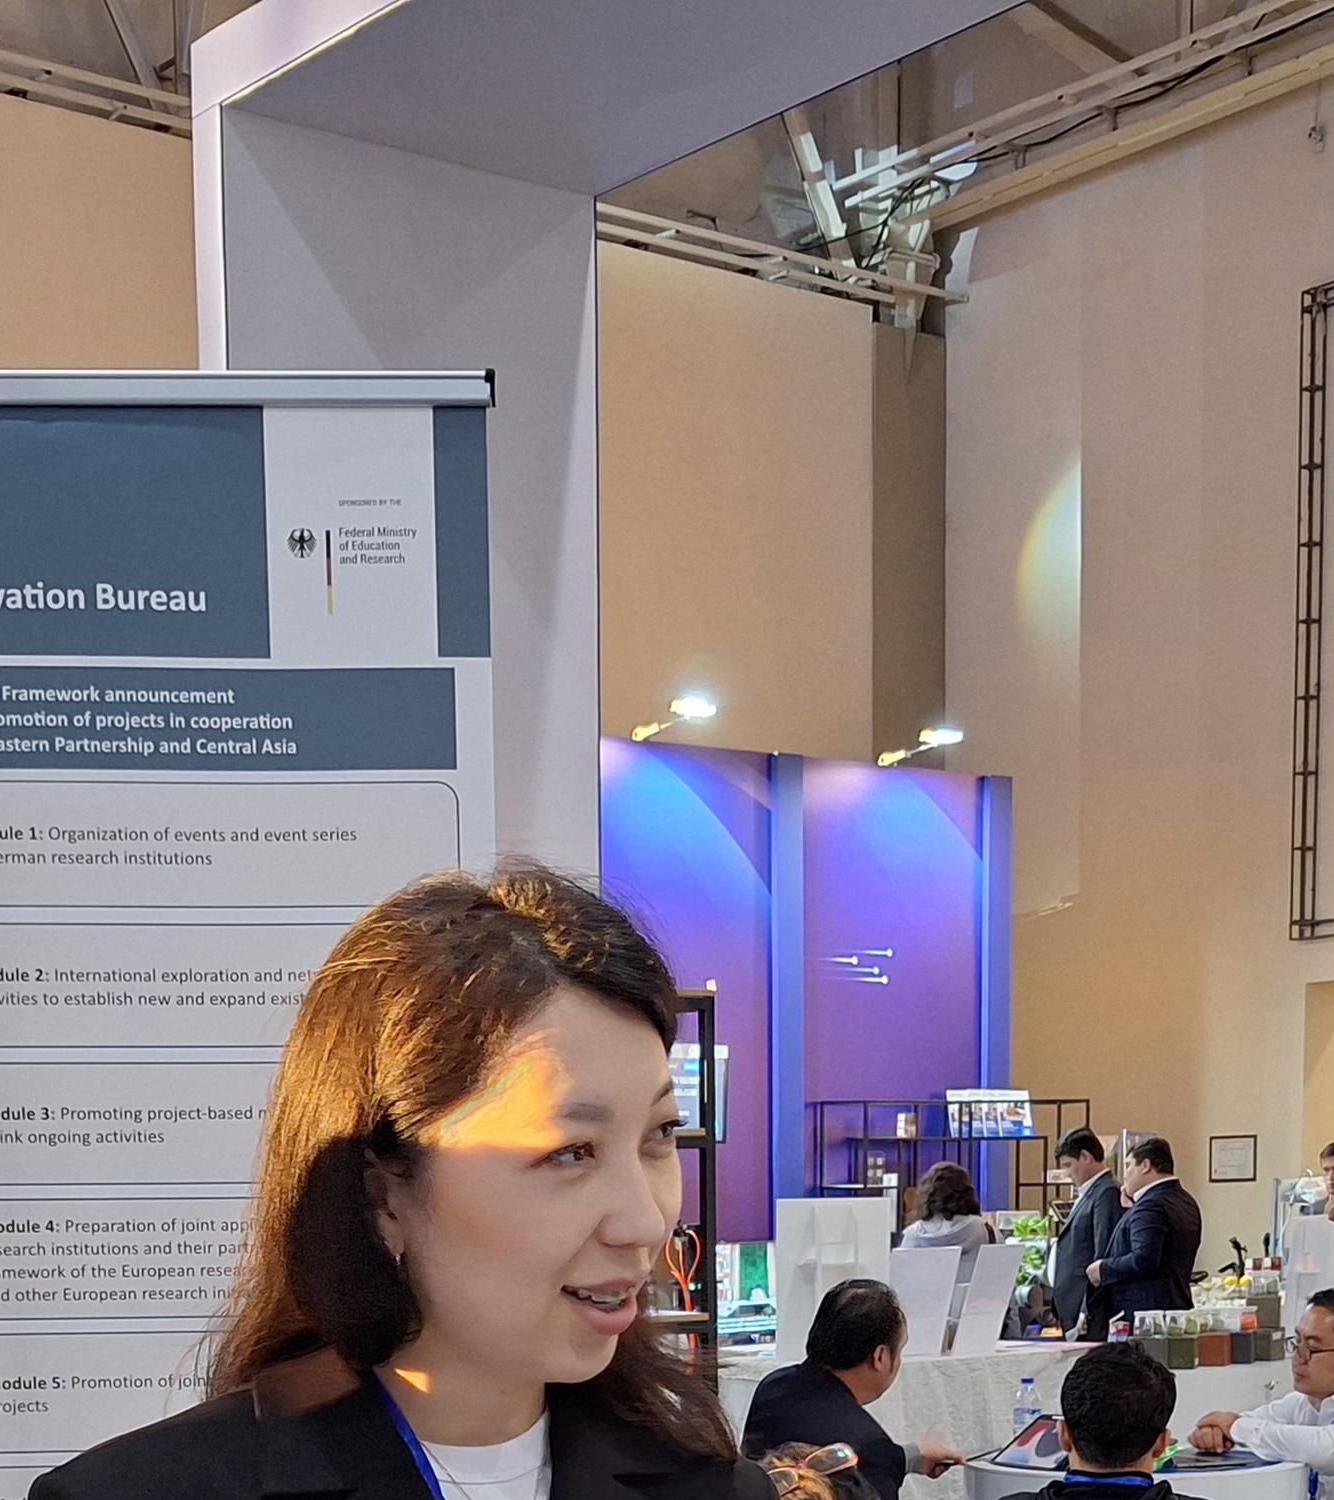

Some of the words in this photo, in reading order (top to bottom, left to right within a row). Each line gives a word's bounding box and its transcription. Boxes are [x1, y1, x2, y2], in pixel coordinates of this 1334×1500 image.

[338, 526, 375, 538] Federal
[377, 526, 417, 539] Ministry
[338, 539, 350, 552] of
[351, 539, 401, 552] Education
[339, 553, 358, 565] and
[360, 552, 406, 565] Research
[96, 582, 206, 612] Bureau
[1, 685, 101, 702] Framework
[104, 689, 235, 704] announcement
[72, 710, 92, 727] of
[95, 711, 165, 731] projects
[169, 712, 186, 729] in
[190, 712, 293, 733] cooperation
[54, 736, 155, 757] Partnership
[159, 737, 191, 754] and
[195, 737, 257, 755] Central
[261, 738, 297, 755] Asia
[29, 826, 44, 841] 1:
[48, 826, 149, 845] Organization
[153, 826, 170, 842] of
[174, 829, 226, 842] events
[230, 826, 259, 842] and
[264, 828, 308, 842] event
[312, 827, 357, 842] series
[51, 849, 119, 865] research
[124, 850, 213, 866] institutions
[34, 968, 50, 983] 2:
[54, 967, 156, 983] International
[161, 967, 250, 985] exploration
[254, 967, 283, 983] and
